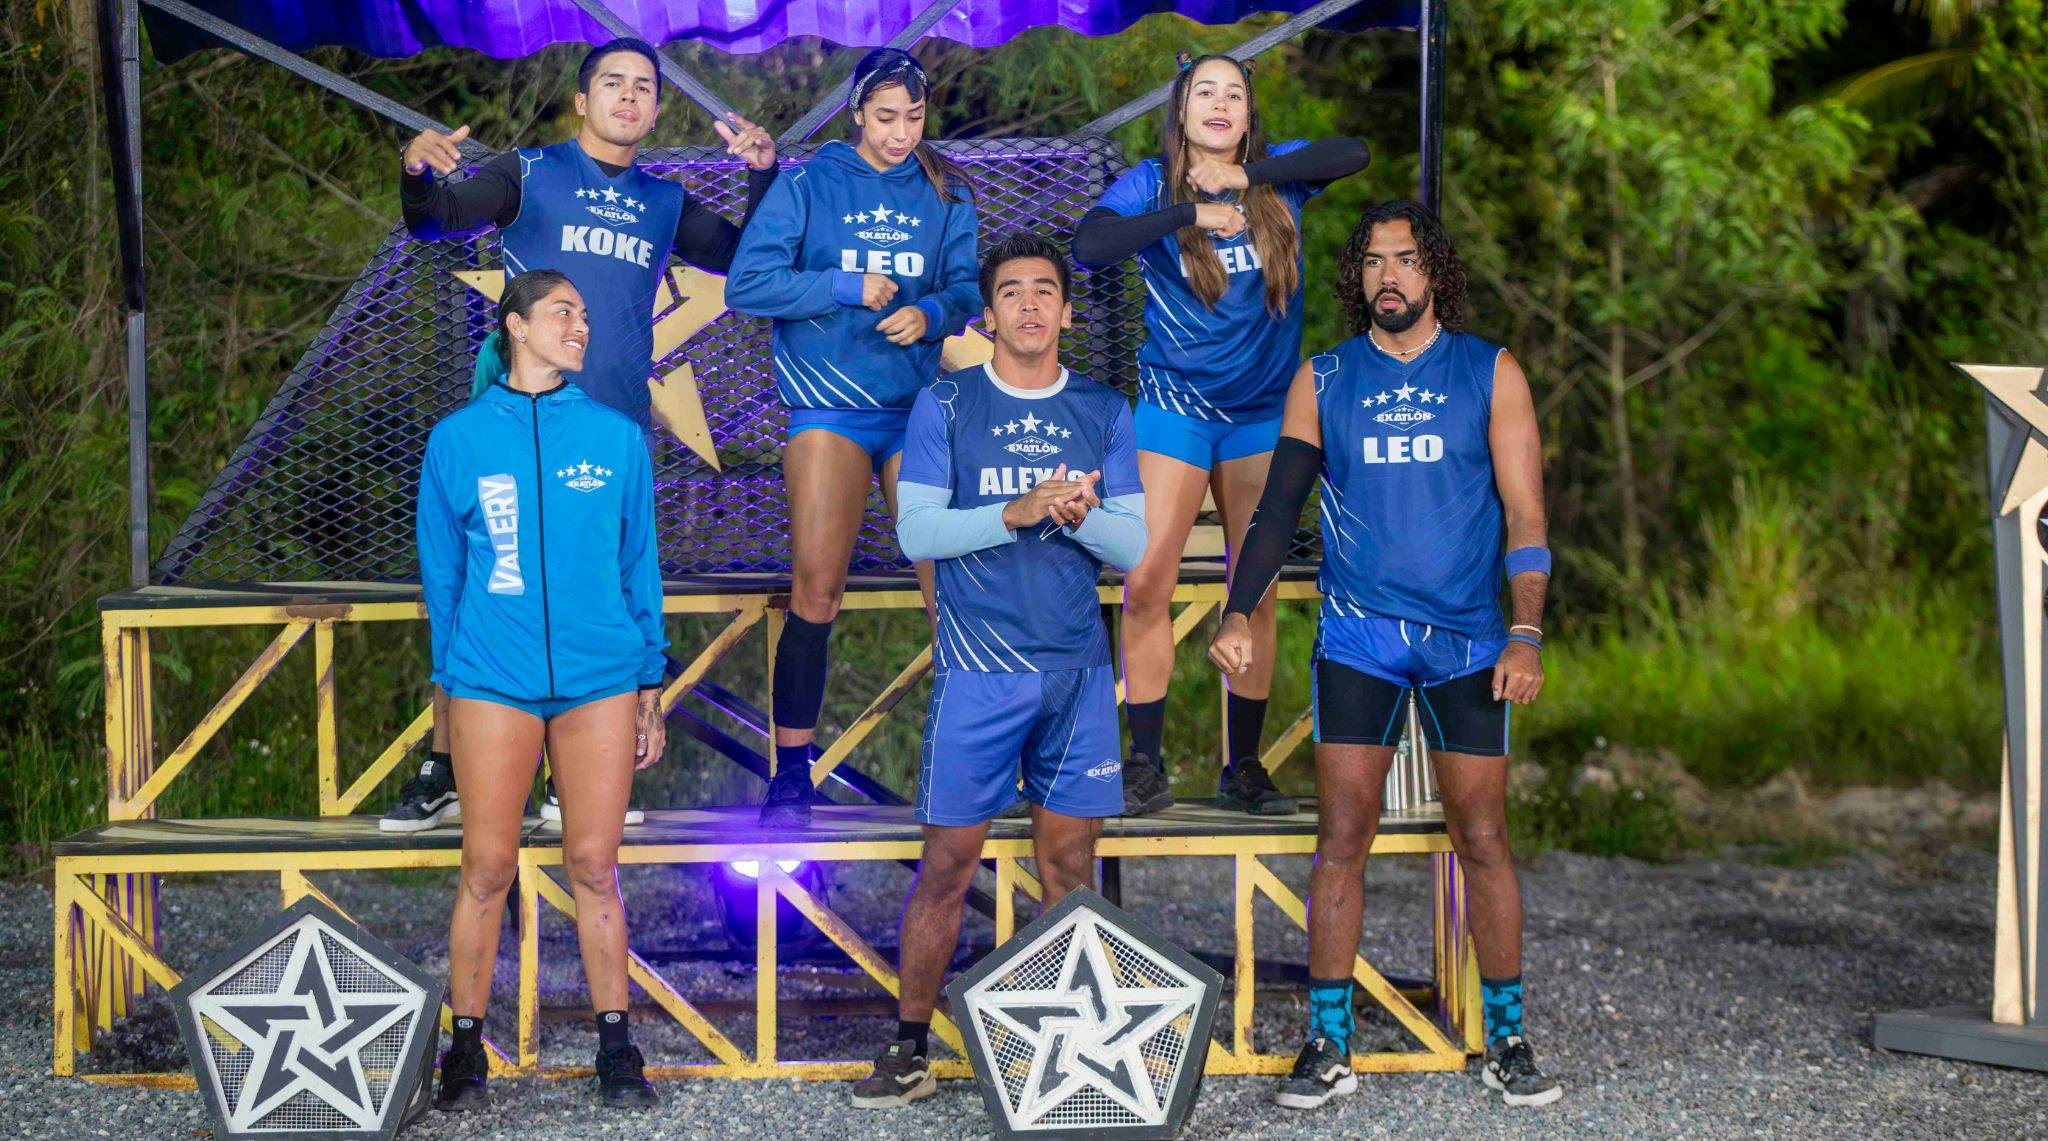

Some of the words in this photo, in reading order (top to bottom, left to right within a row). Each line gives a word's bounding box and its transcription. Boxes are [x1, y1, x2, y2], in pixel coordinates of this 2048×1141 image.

[561, 225, 653, 268] KOKE
[841, 249, 924, 277] LEO
[1363, 434, 1444, 464] LEO
[481, 480, 523, 590] VALERY
